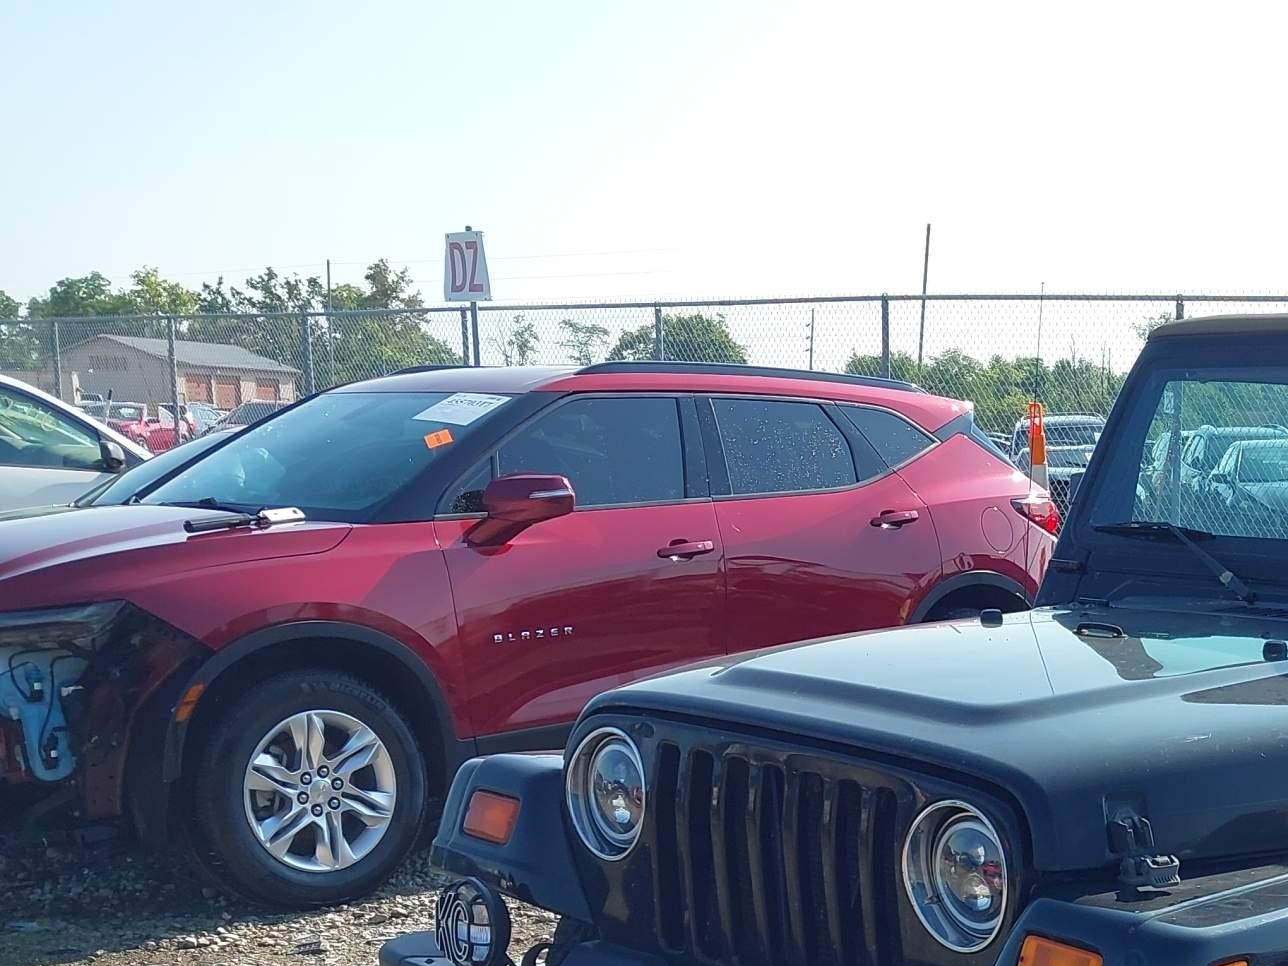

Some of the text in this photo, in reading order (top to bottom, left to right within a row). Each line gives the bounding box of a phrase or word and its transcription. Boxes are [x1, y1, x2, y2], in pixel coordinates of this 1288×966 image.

[448, 241, 484, 293] DZ
[493, 626, 574, 643] BLAZER
[435, 892, 469, 963] KC
